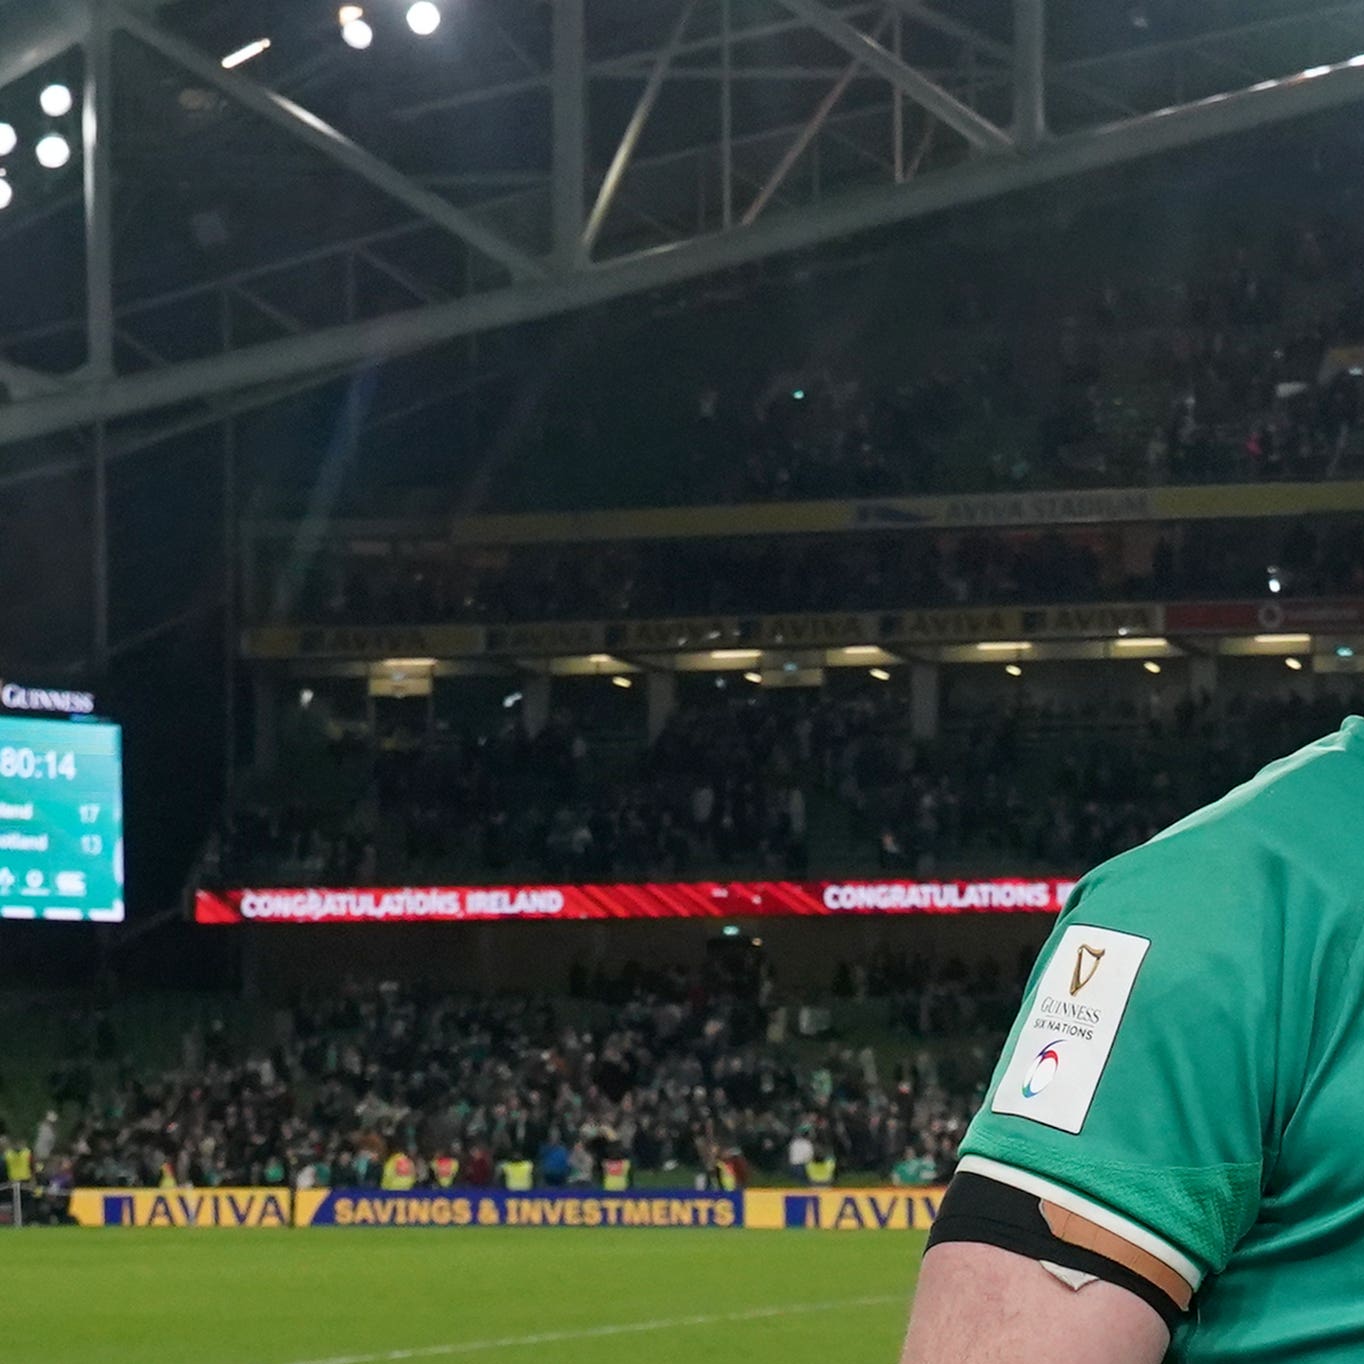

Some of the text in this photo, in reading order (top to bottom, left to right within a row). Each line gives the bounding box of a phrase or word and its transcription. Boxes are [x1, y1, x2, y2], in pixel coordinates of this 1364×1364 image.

[0, 746, 77, 781] 80:14
[465, 889, 564, 915] IRELAND
[823, 883, 1048, 910] CONGRATULATIONS
[1040, 995, 1102, 1024] GUINNESS
[1033, 1018, 1094, 1041] SIX NATIONS
[148, 1194, 291, 1228] AVIVA
[334, 1197, 472, 1226] SAVINGS
[478, 1197, 499, 1226] &
[504, 1198, 735, 1227] INVESTMENTS
